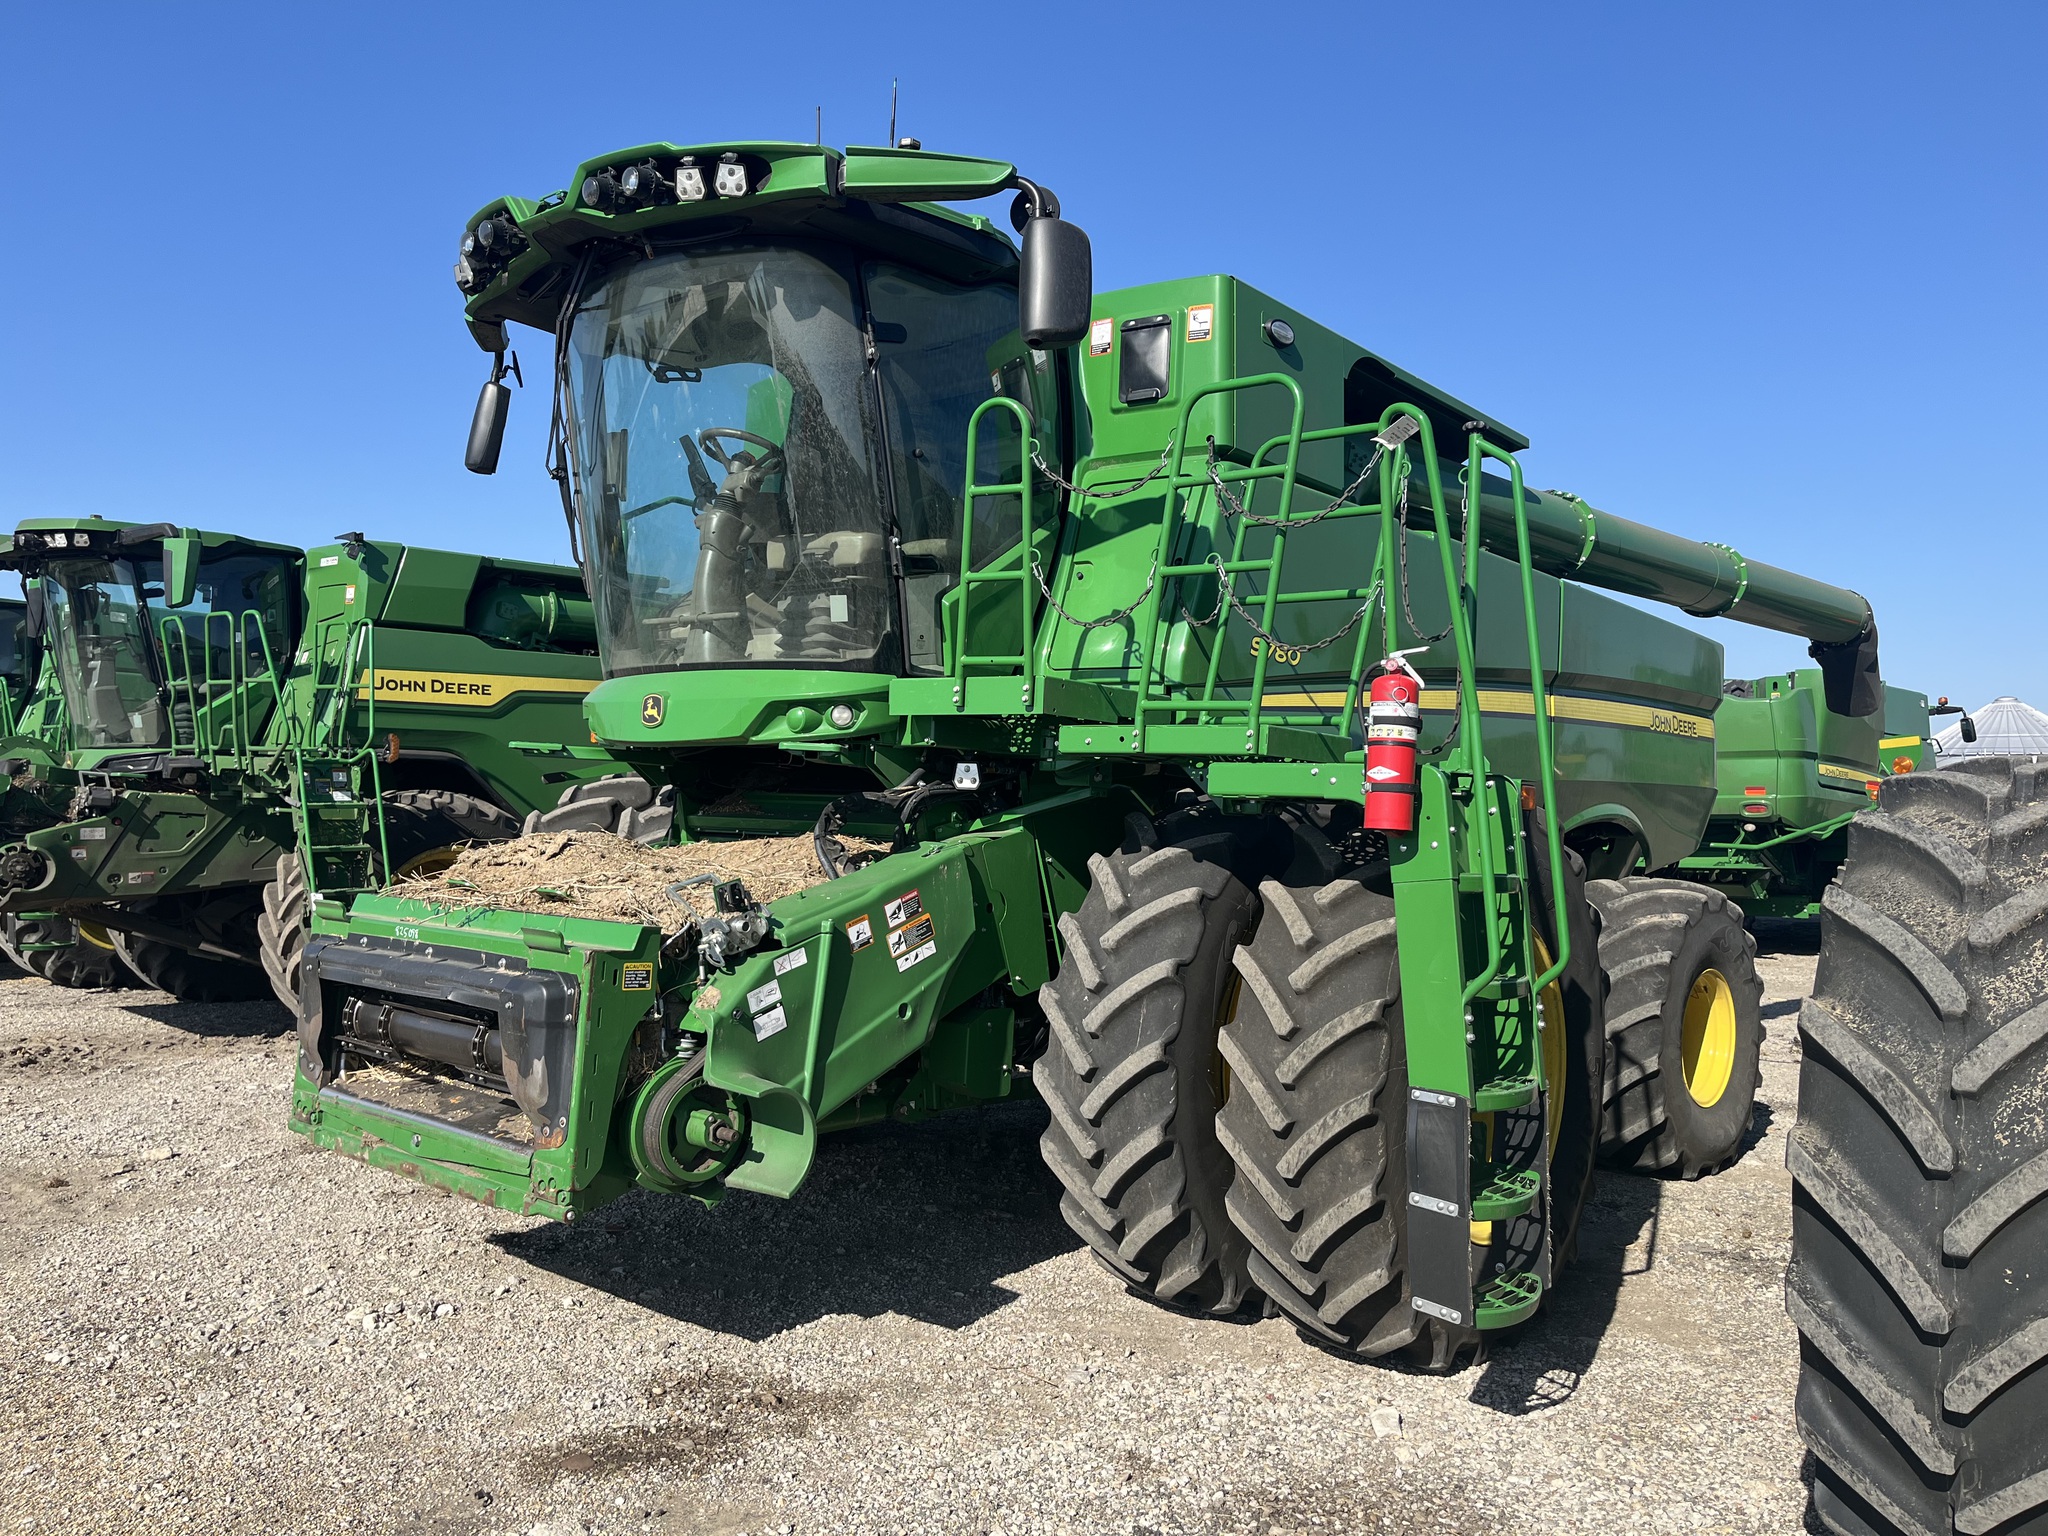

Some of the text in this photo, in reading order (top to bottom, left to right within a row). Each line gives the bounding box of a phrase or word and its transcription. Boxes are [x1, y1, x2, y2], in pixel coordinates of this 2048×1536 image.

[374, 676, 492, 696] JOHN DEERE
[1650, 711, 1698, 736] JOHN DEERE
